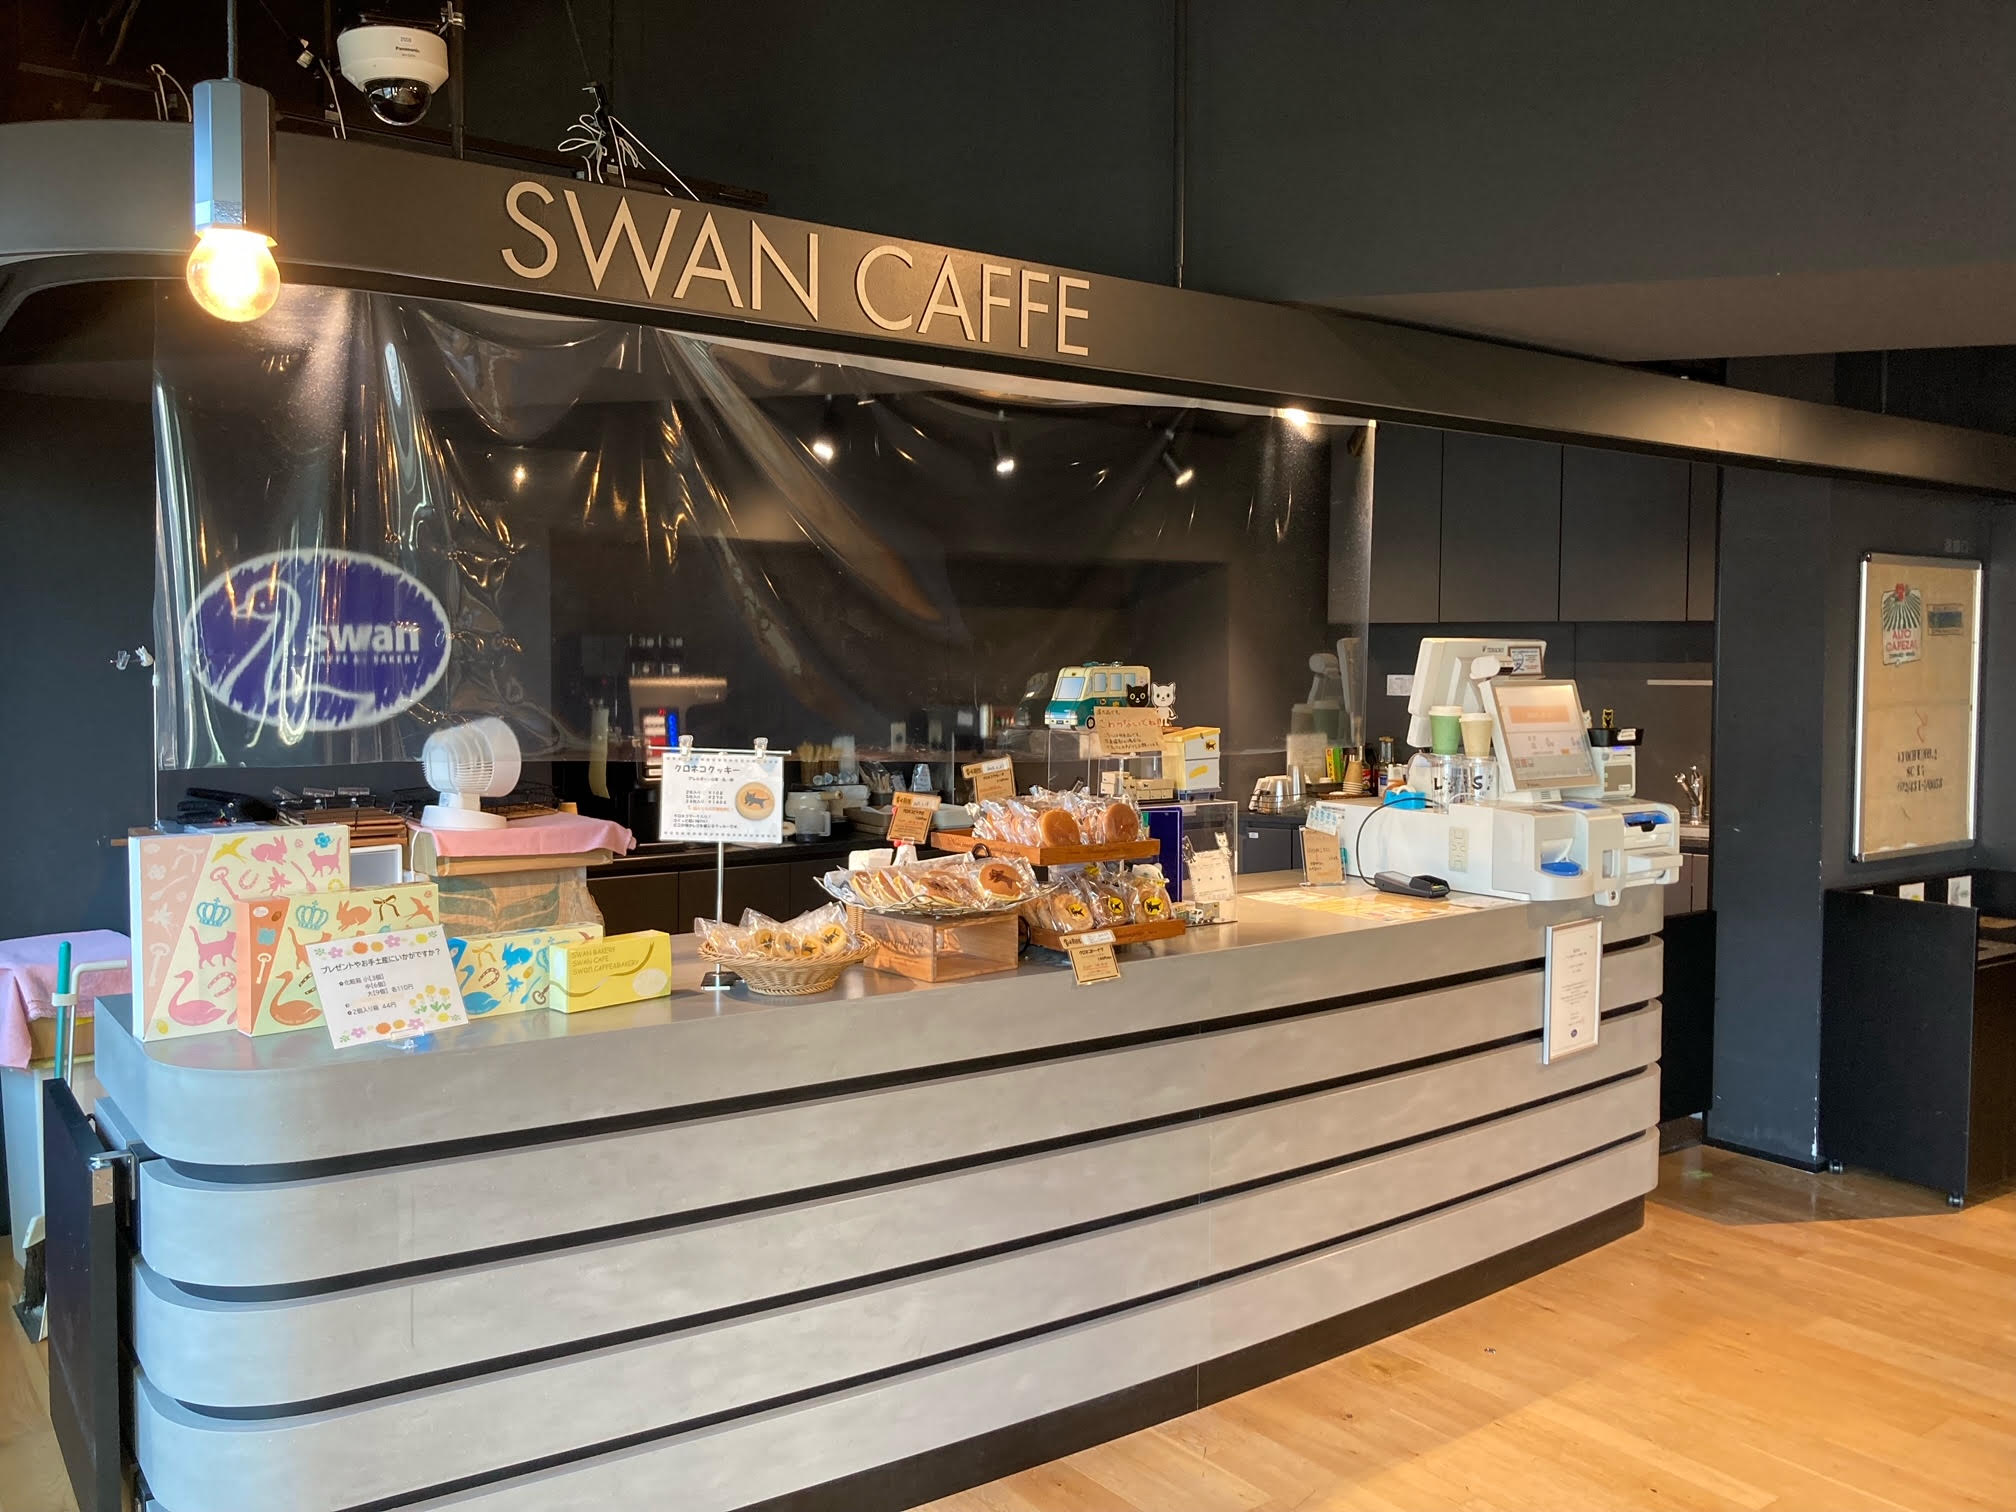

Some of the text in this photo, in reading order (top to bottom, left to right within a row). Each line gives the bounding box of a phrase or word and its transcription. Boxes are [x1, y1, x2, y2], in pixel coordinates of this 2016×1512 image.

[501, 180, 1091, 357] SWAN CAFFE
[308, 622, 420, 653] swan
[674, 764, 741, 775] クロネコクッキー
[1433, 777, 1443, 791] L
[1472, 775, 1483, 790] S
[571, 946, 616, 959] SWAN BAKERY
[320, 947, 441, 975] プレゼントやお手土産にいかがですか？
[572, 955, 609, 967] SWAN CAFE
[382, 1001, 398, 1010] 44円
